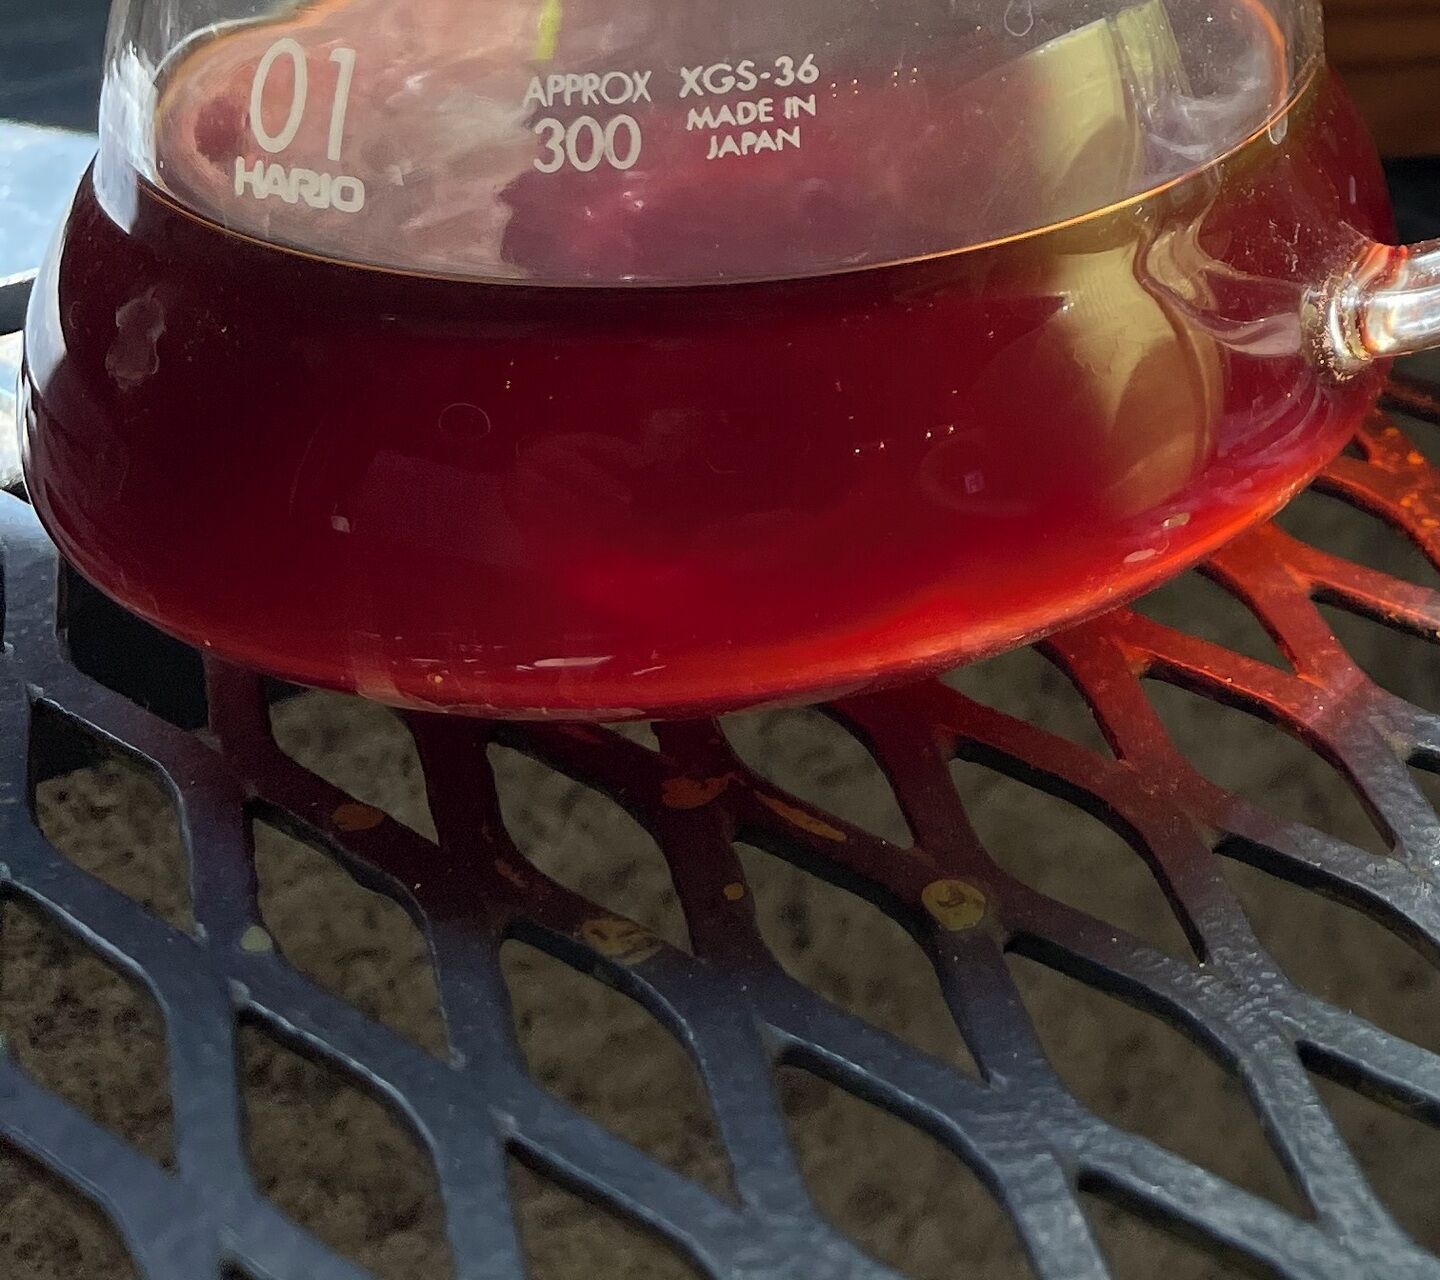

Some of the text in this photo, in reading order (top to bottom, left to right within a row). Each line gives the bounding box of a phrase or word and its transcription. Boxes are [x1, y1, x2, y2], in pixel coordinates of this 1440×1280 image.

[523, 70, 653, 107] APPROX
[679, 53, 820, 99] XGS-36
[249, 37, 357, 162] 01
[686, 94, 817, 130] MADE IN
[533, 113, 643, 175] 300
[706, 126, 802, 160] JAPAN
[234, 157, 366, 214] HARIO
